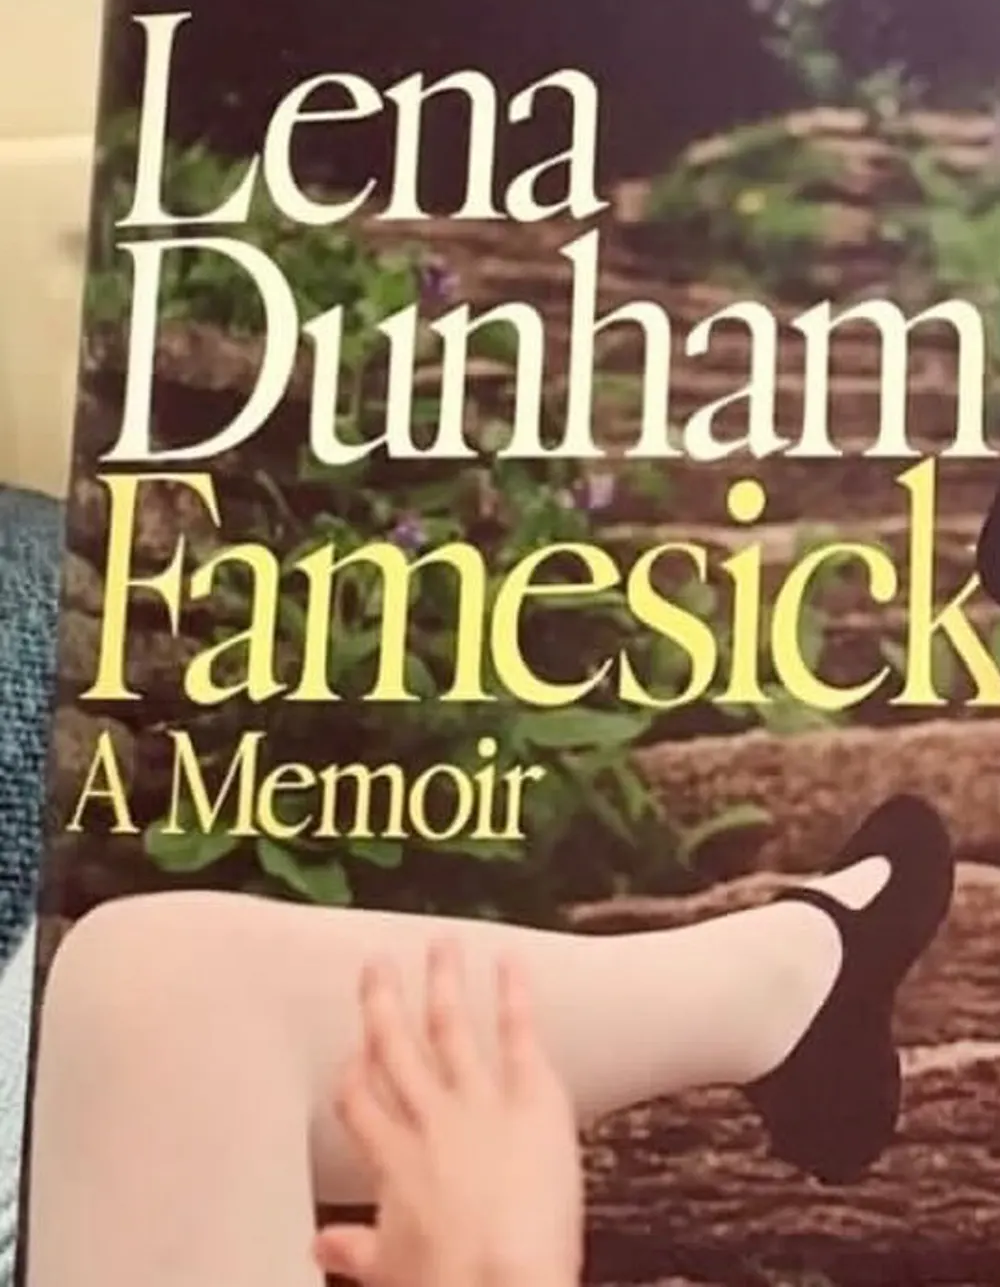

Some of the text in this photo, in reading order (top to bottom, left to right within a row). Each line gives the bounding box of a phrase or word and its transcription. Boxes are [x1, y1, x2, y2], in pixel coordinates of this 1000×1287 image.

[116, 12, 609, 227] Lena
[98, 230, 1000, 465] Dunham
[67, 730, 545, 841] A Memoir
